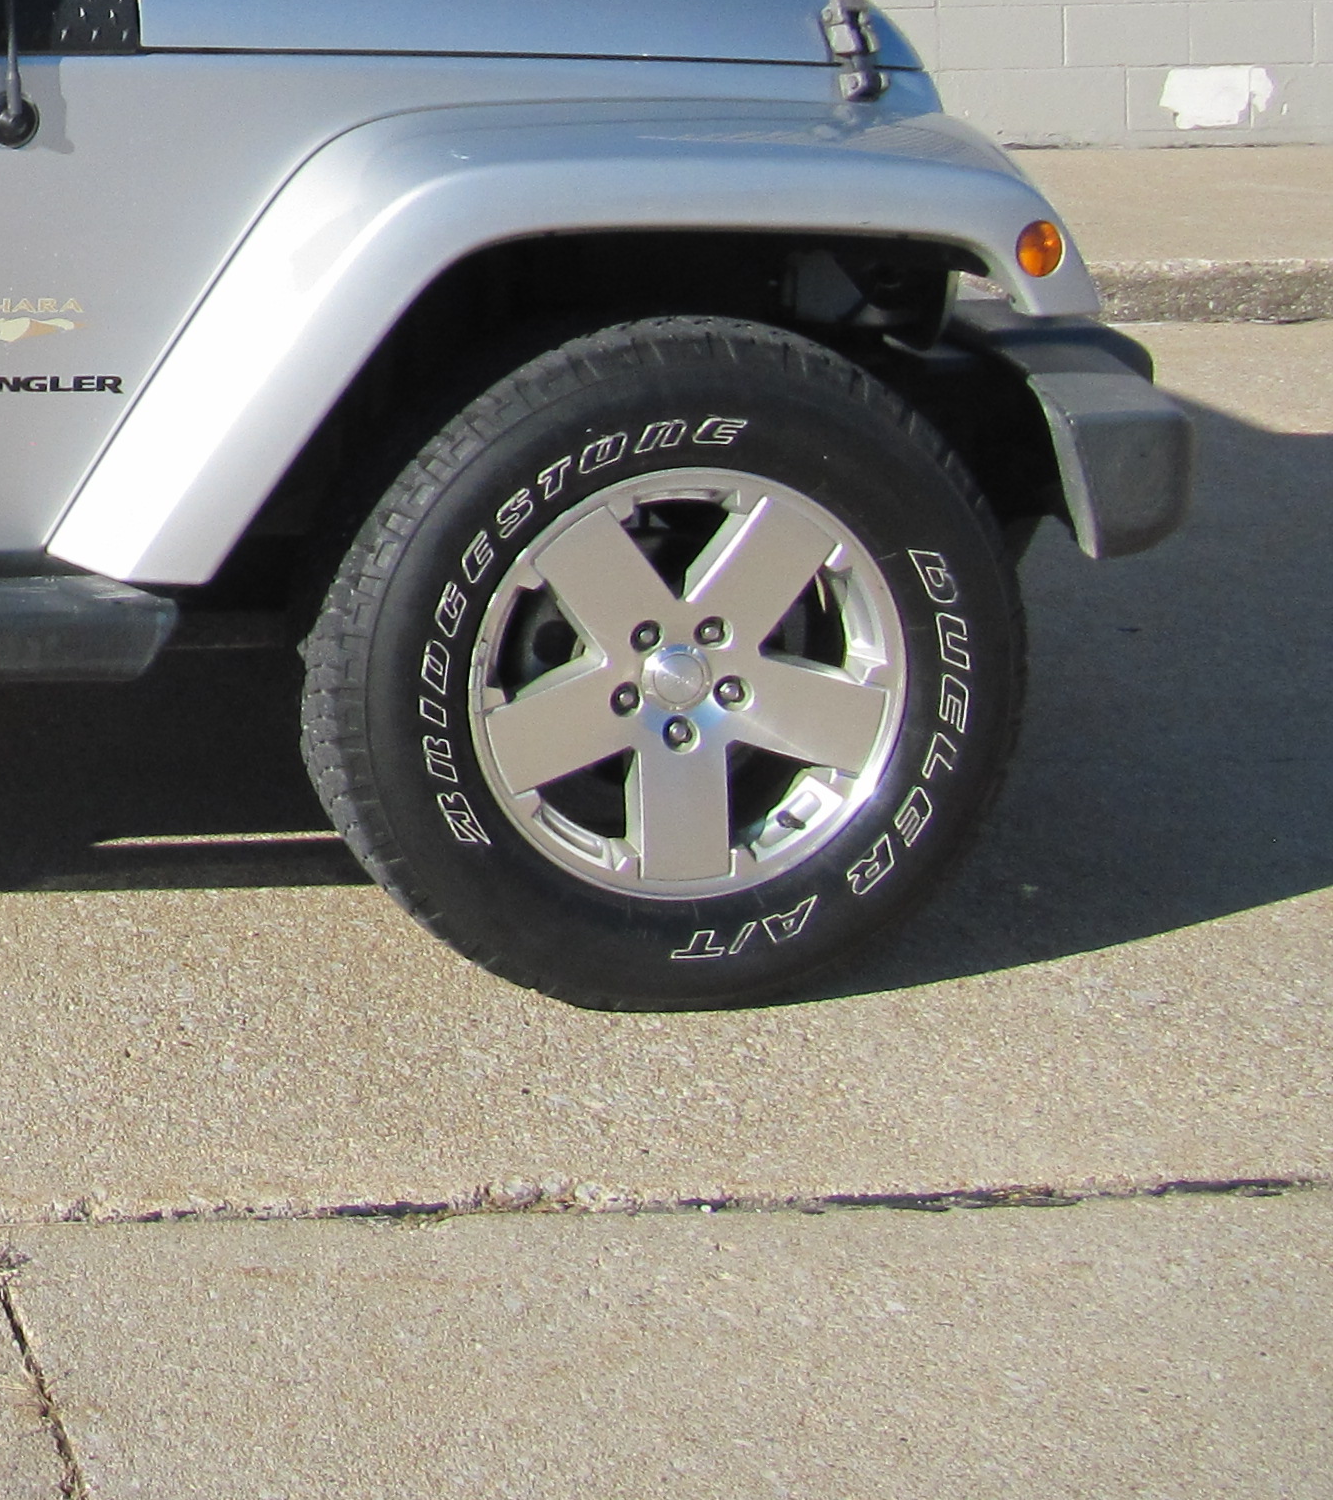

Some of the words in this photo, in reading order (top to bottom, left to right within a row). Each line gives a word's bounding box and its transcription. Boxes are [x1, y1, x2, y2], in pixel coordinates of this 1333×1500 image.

[418, 414, 749, 847] BRIDGESTONE
[847, 547, 972, 897] DUELER
[669, 894, 819, 961] A/T
